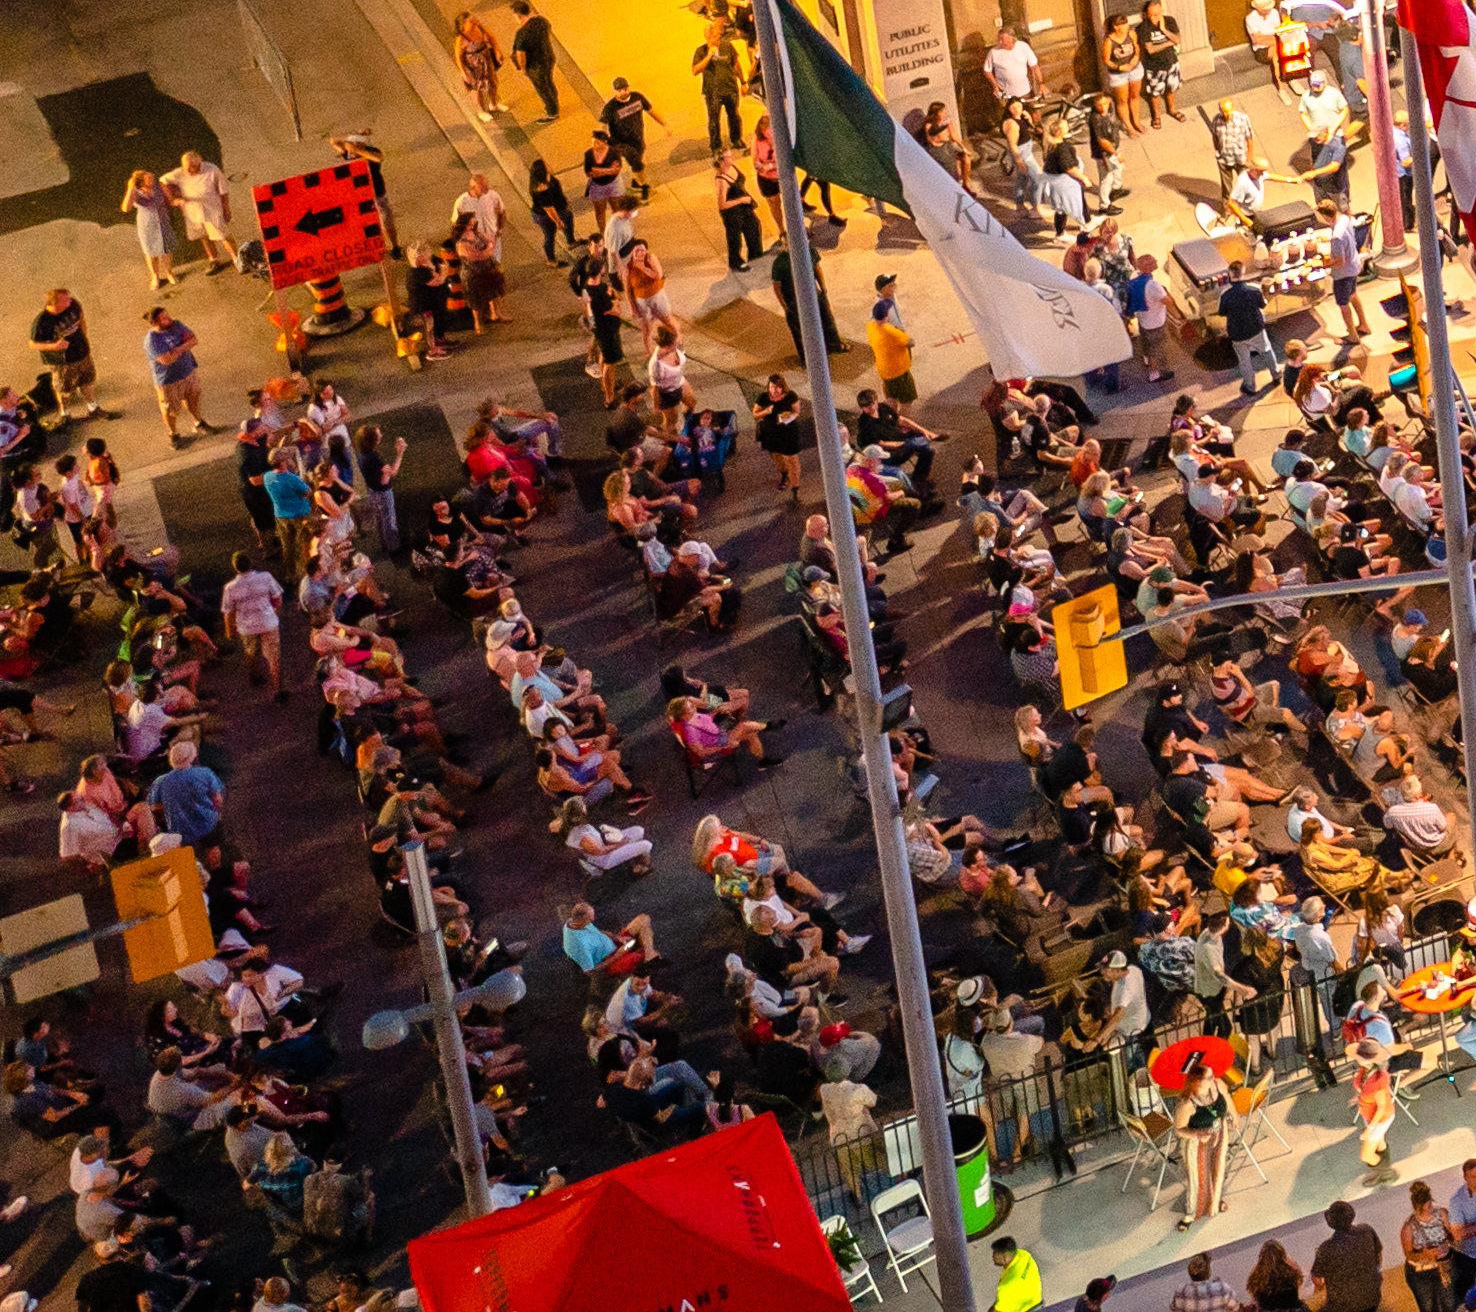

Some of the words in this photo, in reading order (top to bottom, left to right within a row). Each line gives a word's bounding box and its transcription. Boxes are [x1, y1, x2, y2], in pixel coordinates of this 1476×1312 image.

[888, 24, 932, 43] PUBLIC
[883, 38, 943, 61] UTILITIES
[884, 53, 946, 76] BUILDING
[323, 237, 386, 263] CLOSED
